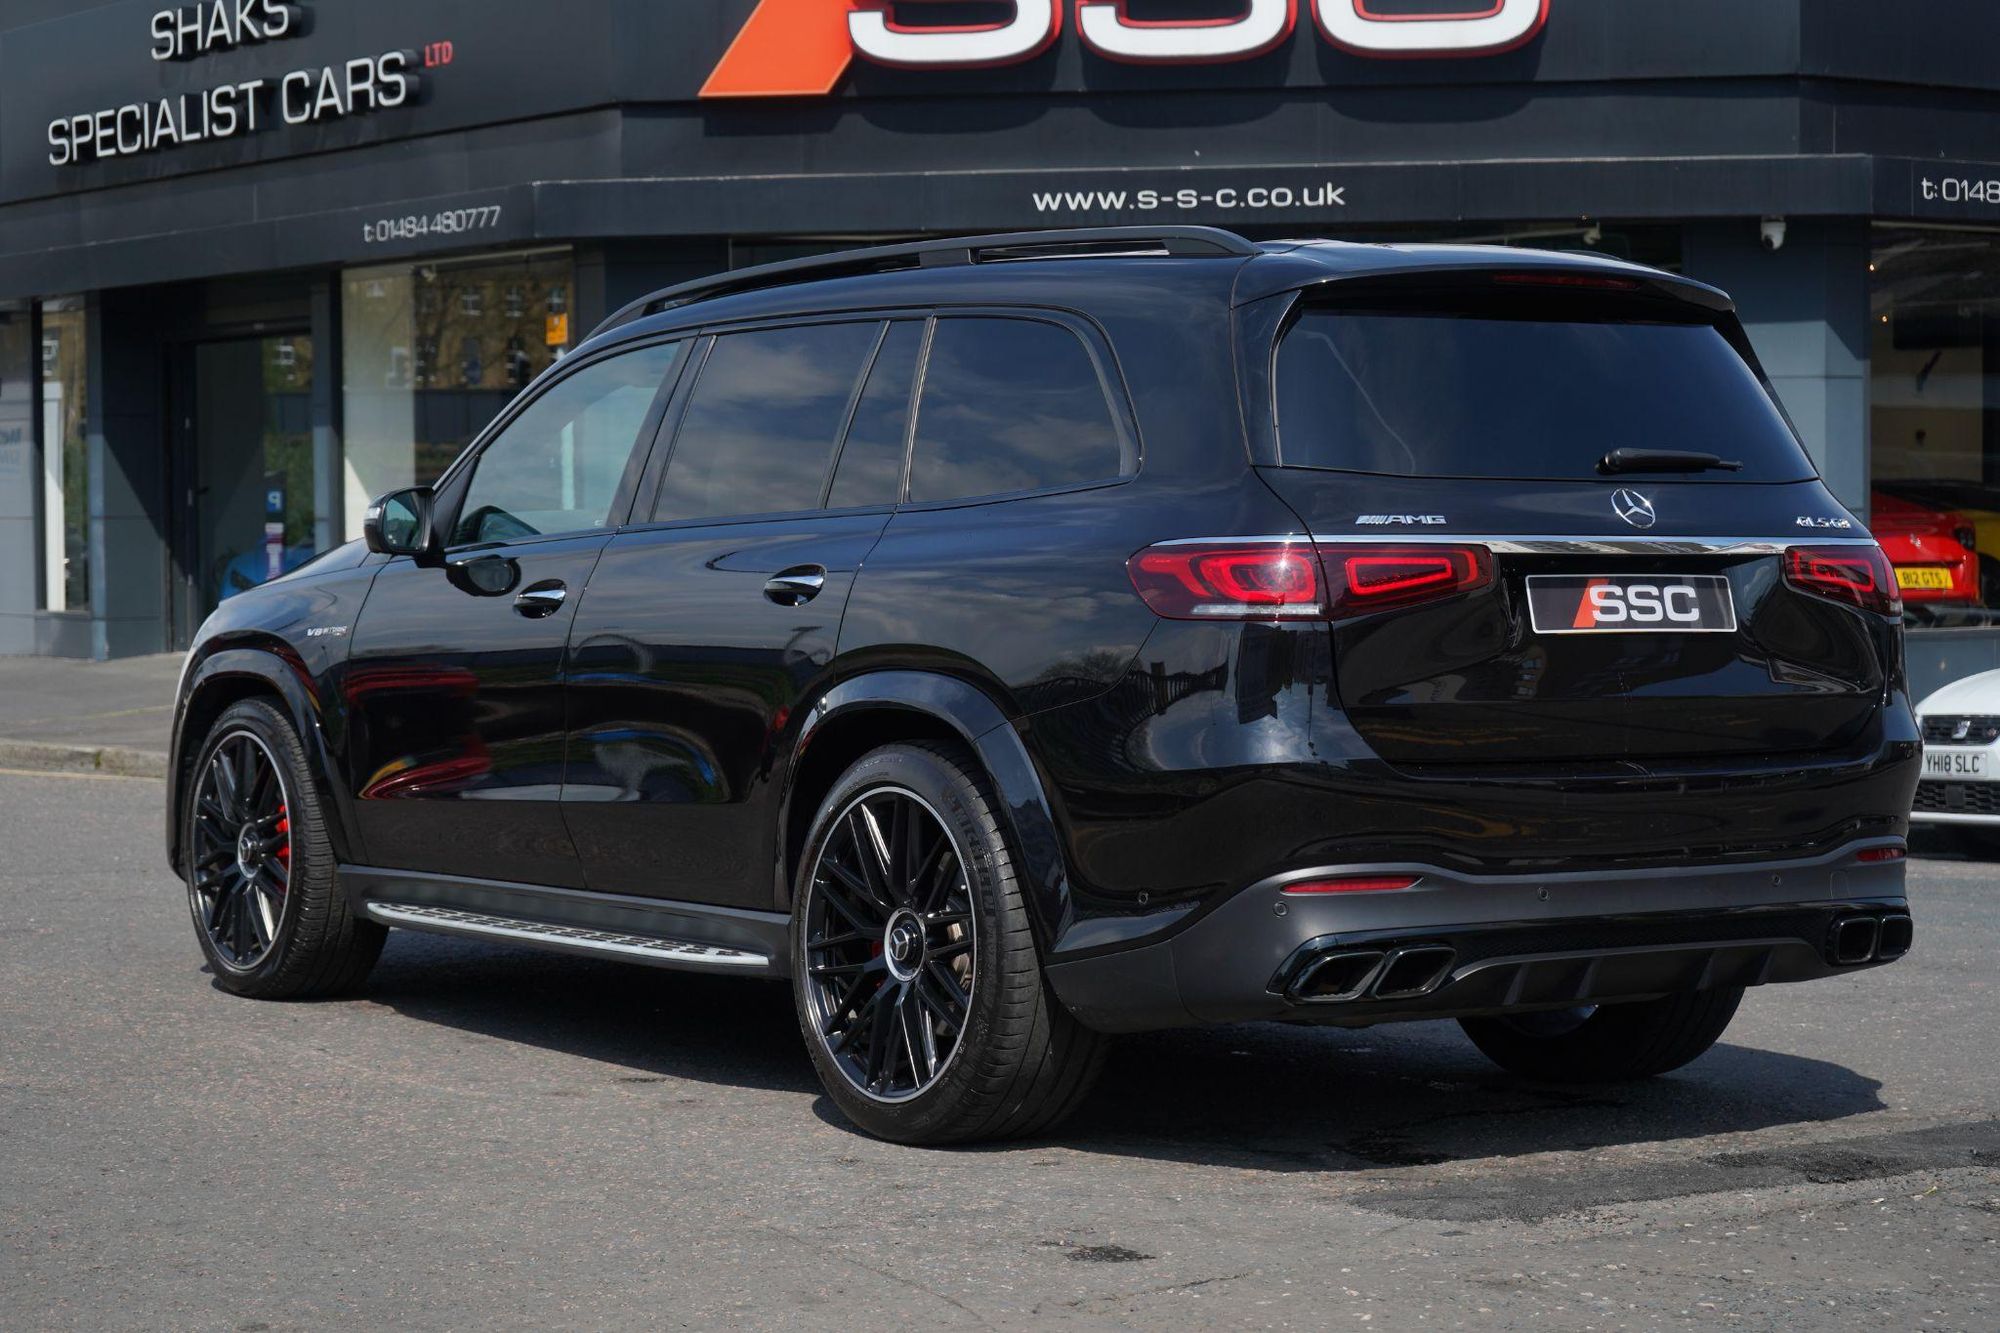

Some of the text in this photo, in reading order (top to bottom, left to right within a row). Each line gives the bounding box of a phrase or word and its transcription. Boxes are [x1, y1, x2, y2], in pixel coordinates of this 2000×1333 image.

[151, 0, 290, 61] SHAKS
[48, 41, 453, 165] SPECIALIST CARS LTD
[1032, 182, 1346, 211] www.s-s-c.co.uk
[1589, 585, 1700, 622] SSC
[1926, 755, 1980, 773] YH18 SLC
